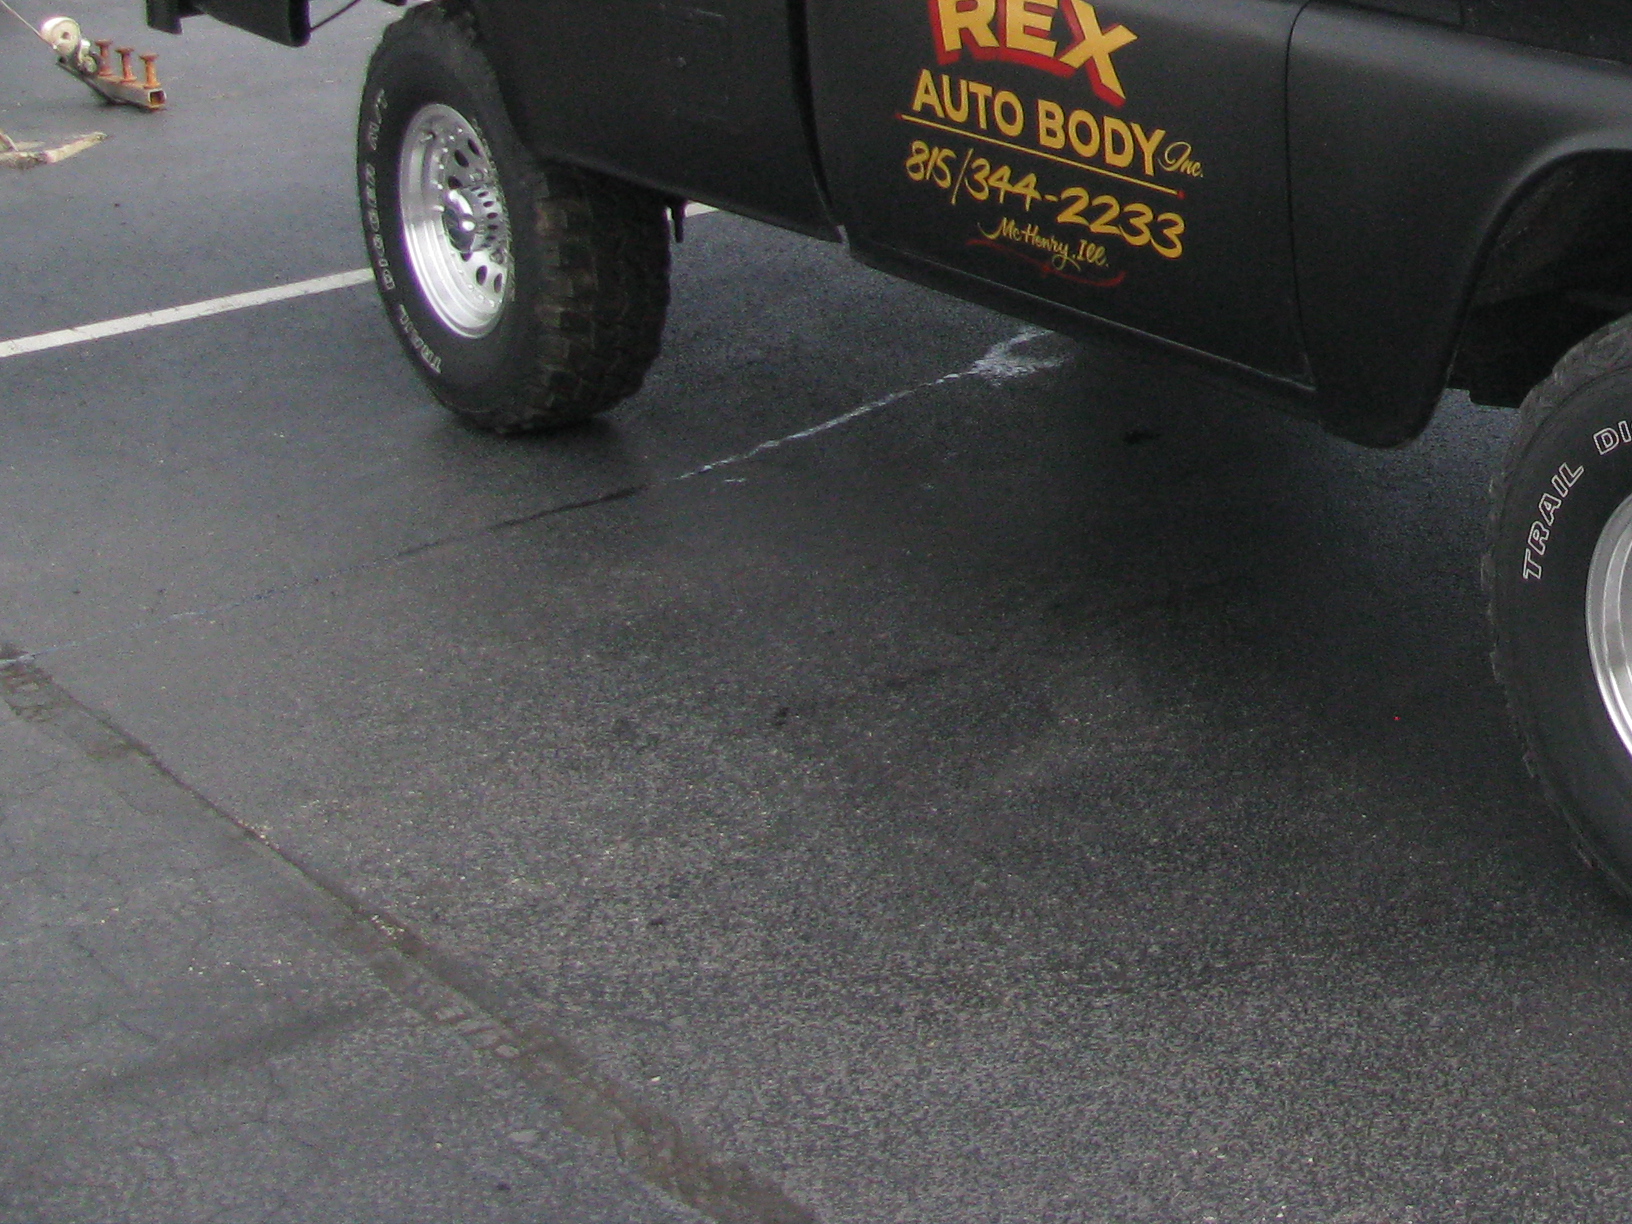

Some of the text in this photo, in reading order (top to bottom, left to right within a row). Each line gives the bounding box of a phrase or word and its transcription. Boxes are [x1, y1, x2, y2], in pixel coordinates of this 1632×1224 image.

[911, 68, 1204, 178] AUTO BODY Inc.
[904, 139, 1186, 260] 815/344-2233
[1522, 462, 1585, 582] TRAIL
